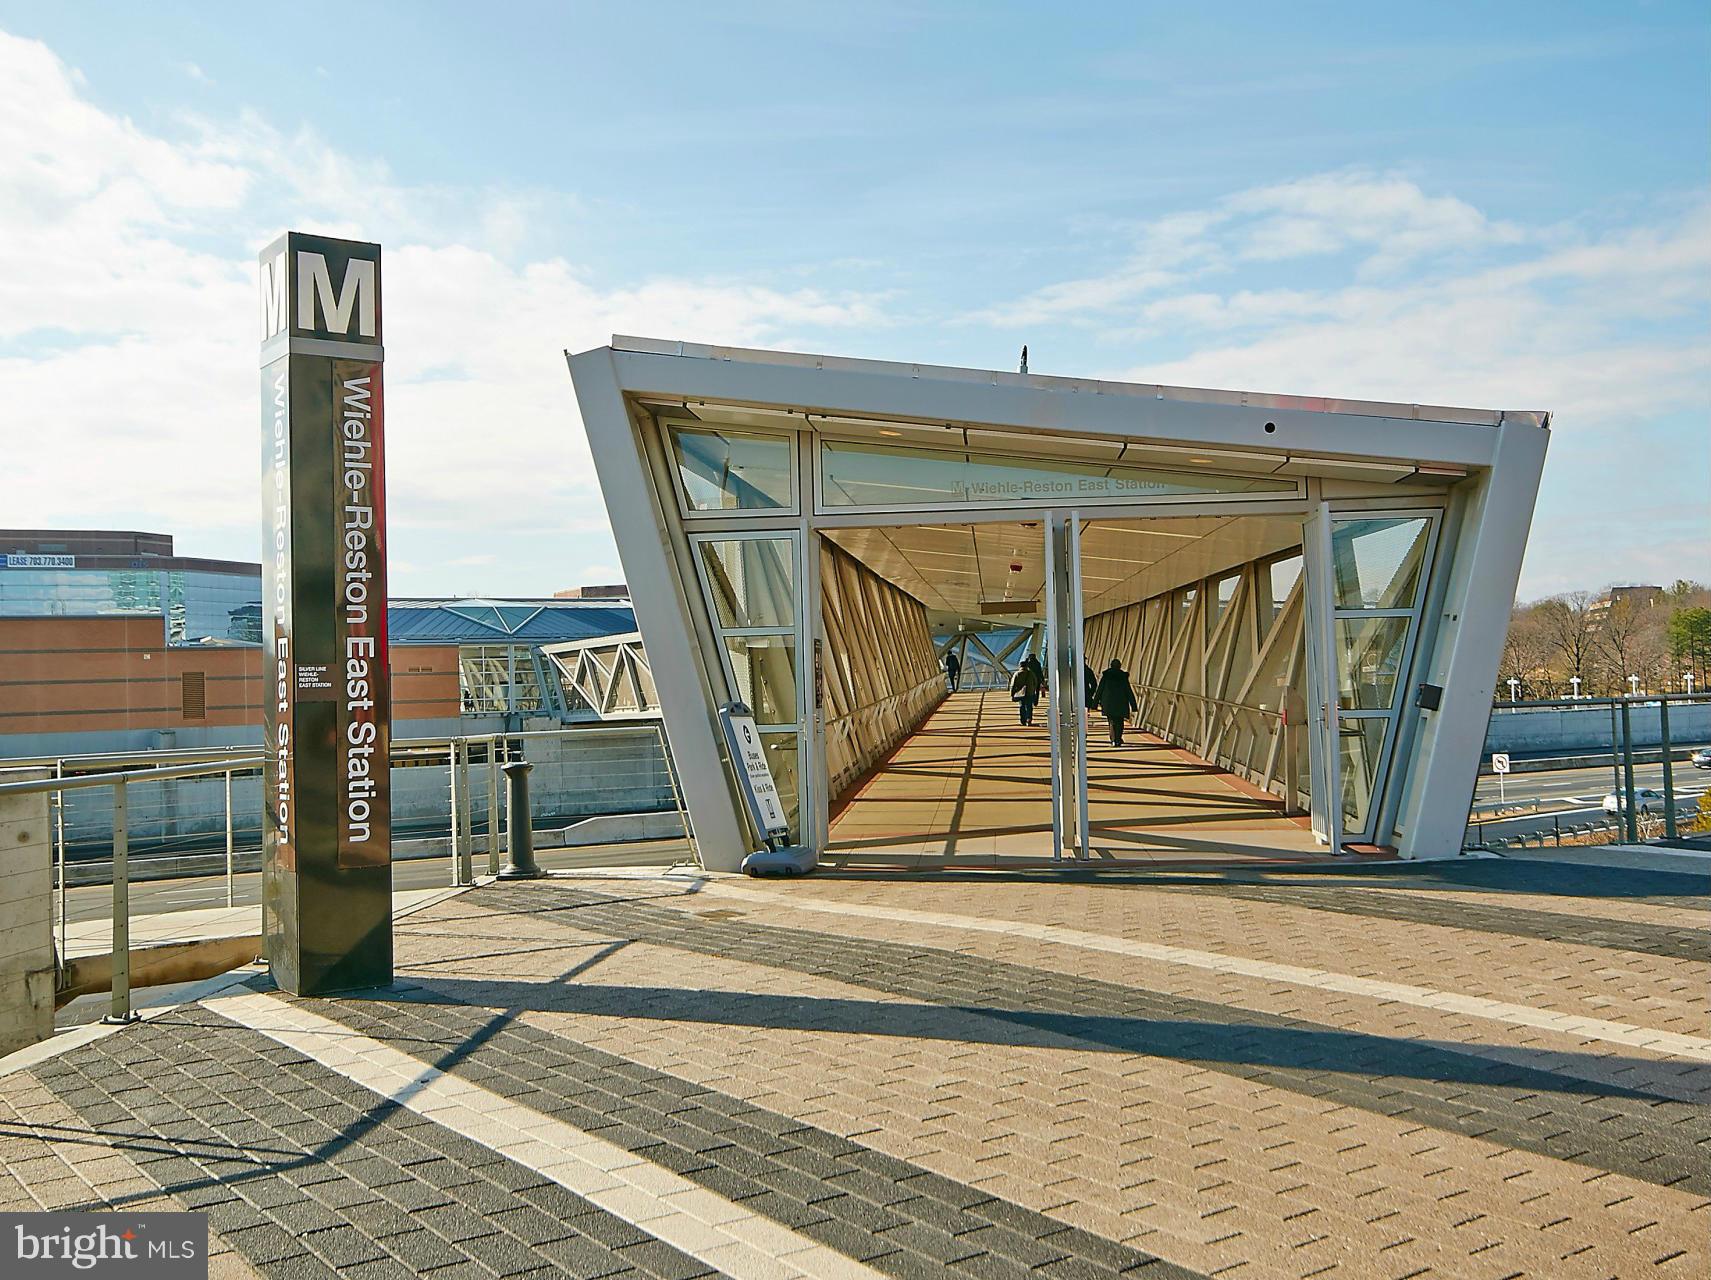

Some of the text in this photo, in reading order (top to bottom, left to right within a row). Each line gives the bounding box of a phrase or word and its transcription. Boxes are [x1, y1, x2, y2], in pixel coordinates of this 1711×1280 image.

[260, 252, 287, 342] M
[297, 251, 375, 337] M
[971, 479, 1073, 494] Wiehle-Reston
[1078, 479, 1110, 491] East
[8, 556, 28, 566] LEASE
[274, 373, 290, 844] Wiehle-Reston East Station
[343, 377, 377, 842] Wiehle-Reston East Station
